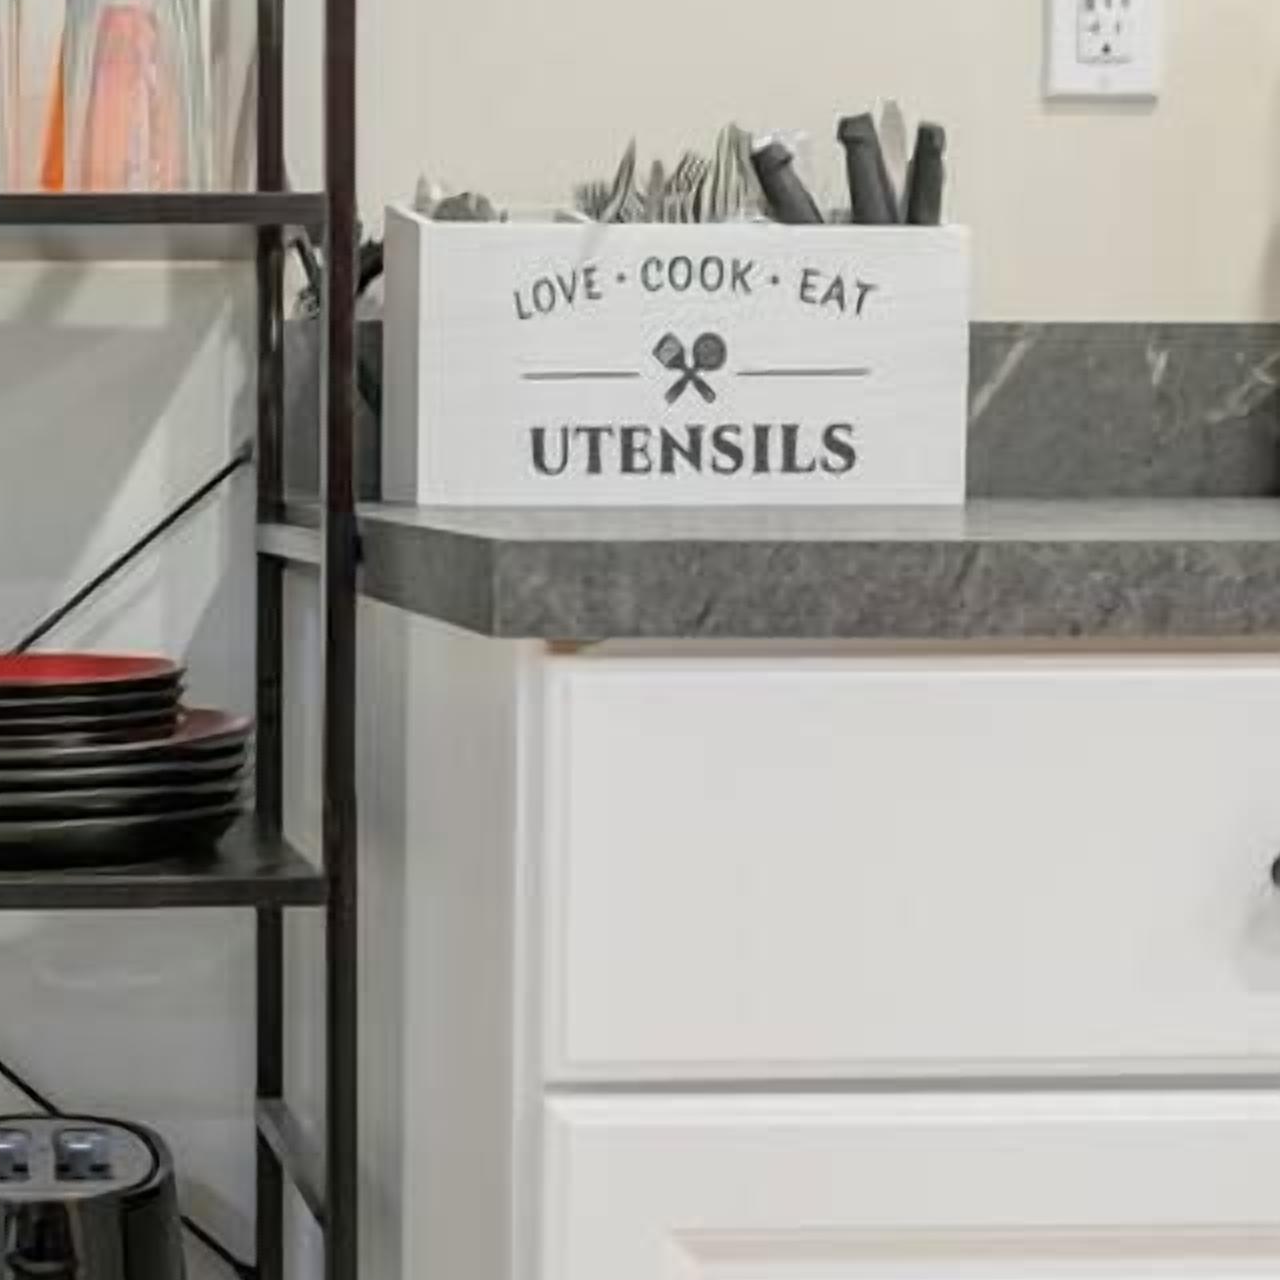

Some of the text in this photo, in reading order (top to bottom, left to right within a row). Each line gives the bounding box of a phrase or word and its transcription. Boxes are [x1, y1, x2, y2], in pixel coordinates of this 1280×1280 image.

[513, 255, 879, 320] LOVE COOK EAT
[529, 422, 858, 476] UTENSILS
